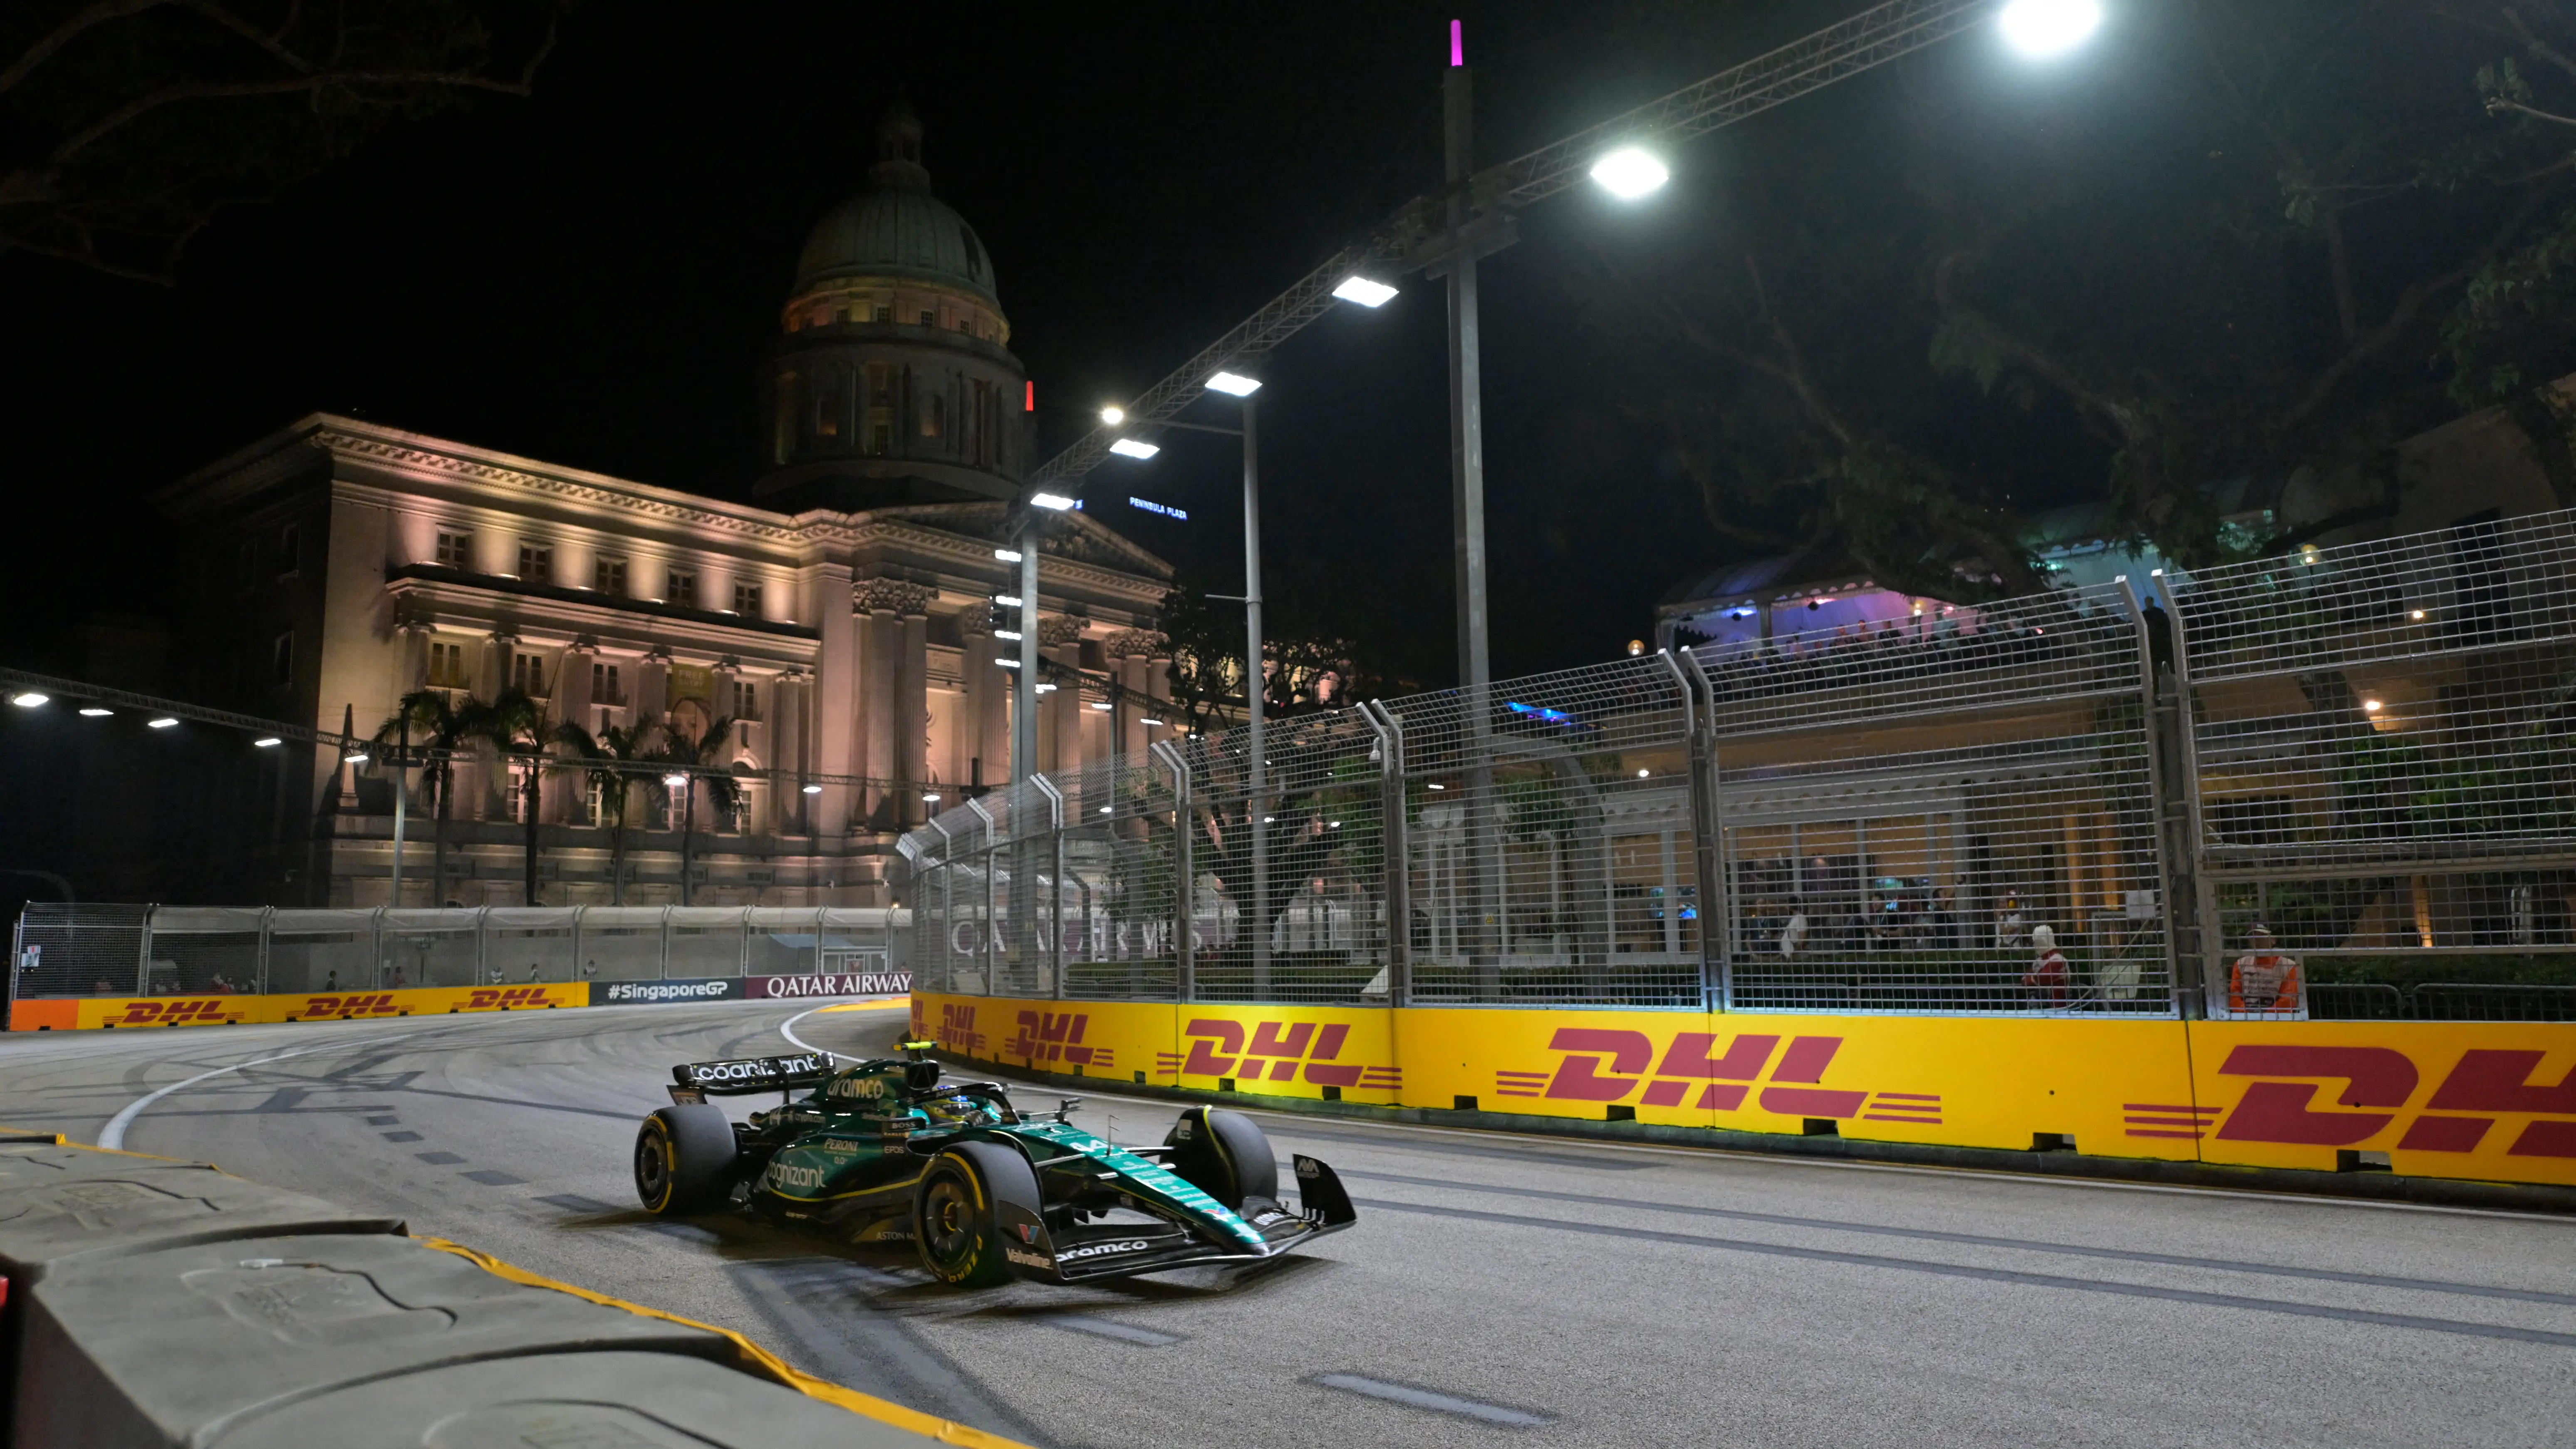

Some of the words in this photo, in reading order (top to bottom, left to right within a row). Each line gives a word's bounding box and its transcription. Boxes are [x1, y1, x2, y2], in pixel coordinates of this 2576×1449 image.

[1129, 497, 1165, 514] PENINSULA
[1167, 506, 1187, 520] PLAZA
[608, 981, 728, 1000] #SingaporeGP
[767, 976, 836, 998] QATAR
[842, 973, 913, 993] AIRWAY
[303, 994, 400, 1016] DHL
[468, 988, 553, 1008] DHL
[122, 1001, 230, 1023] DHL
[942, 1003, 978, 1048] DHL
[1015, 1010, 1094, 1064] DHL
[1182, 1019, 1363, 1087] DHL
[1544, 1028, 1869, 1118] DHL
[826, 1077, 884, 1099] aramco
[2215, 1045, 2576, 1158] DH
[824, 1138, 859, 1152] PERONI
[884, 1146, 904, 1154] EPOS
[876, 1231, 906, 1241] ASTON
[1006, 1247, 1051, 1269] Valvoline
[1055, 1240, 1148, 1262] aramco
